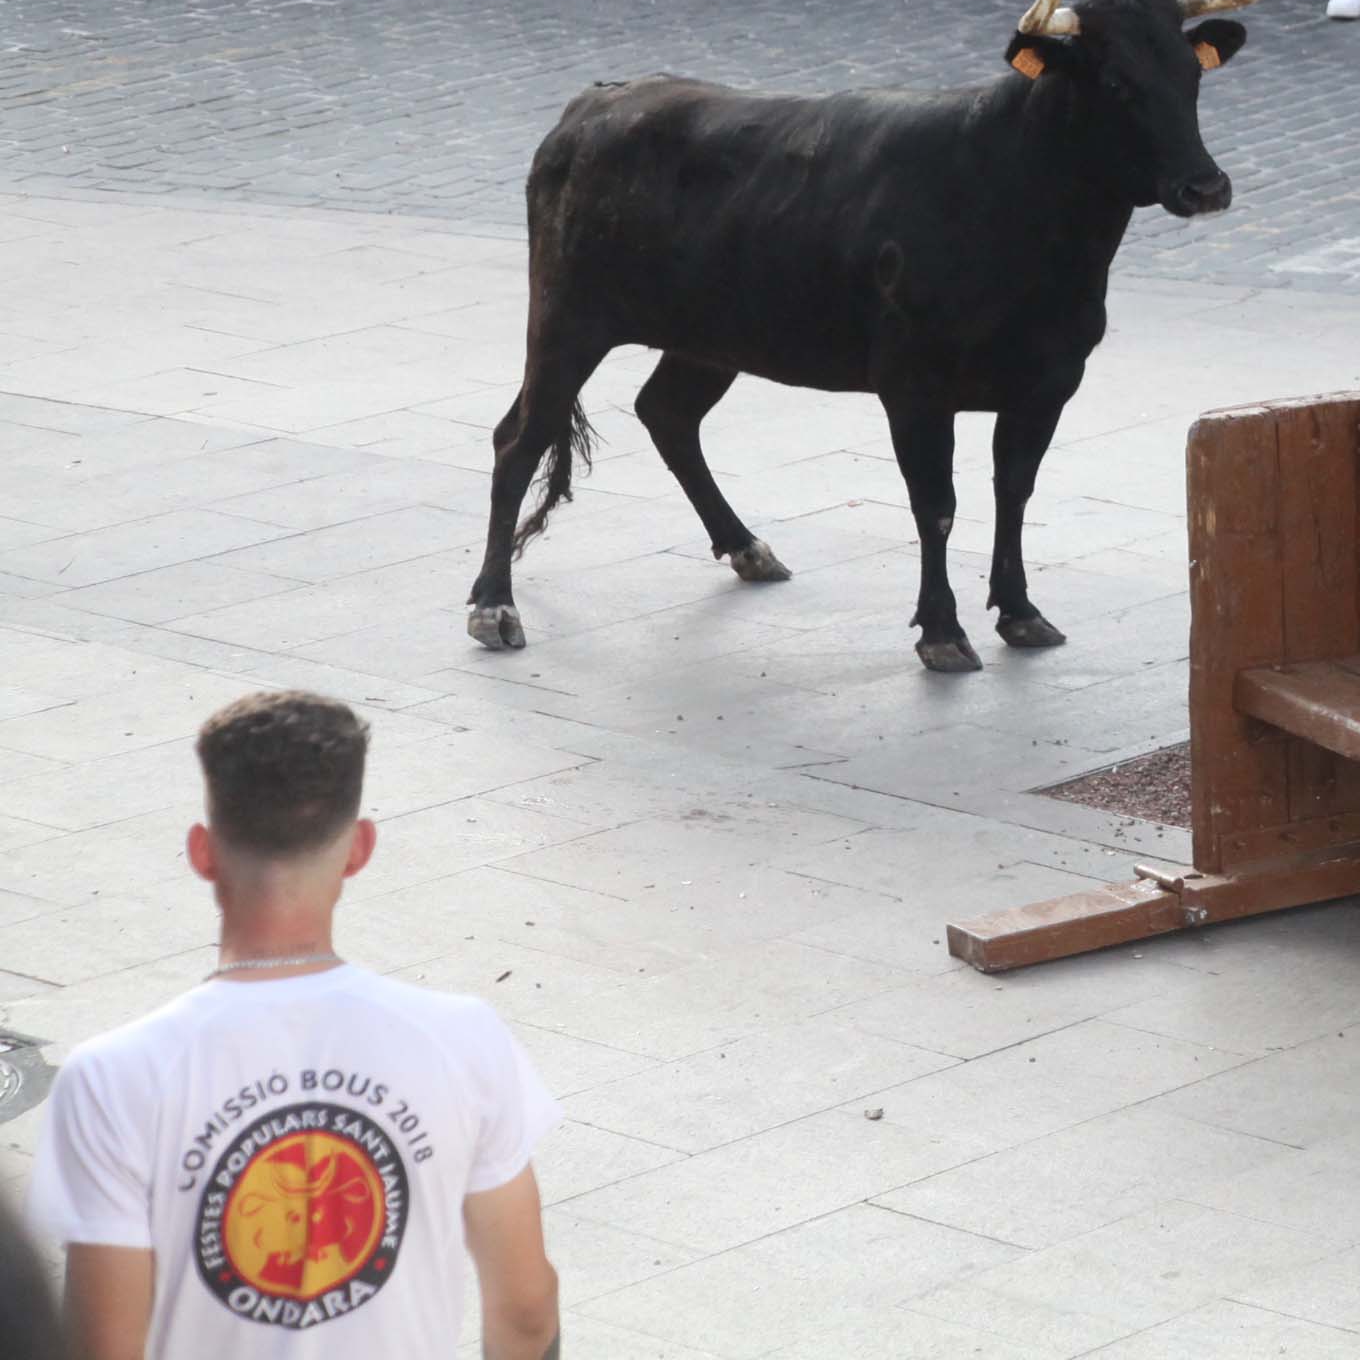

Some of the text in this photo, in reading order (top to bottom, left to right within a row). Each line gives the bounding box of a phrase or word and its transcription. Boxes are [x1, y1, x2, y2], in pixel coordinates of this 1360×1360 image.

[300, 1068, 389, 1106] BOUS
[387, 1099, 435, 1164] 2018
[200, 1109, 402, 1270] FESTES POPULARS SANT JAUME
[227, 1280, 378, 1327] ONDARA
